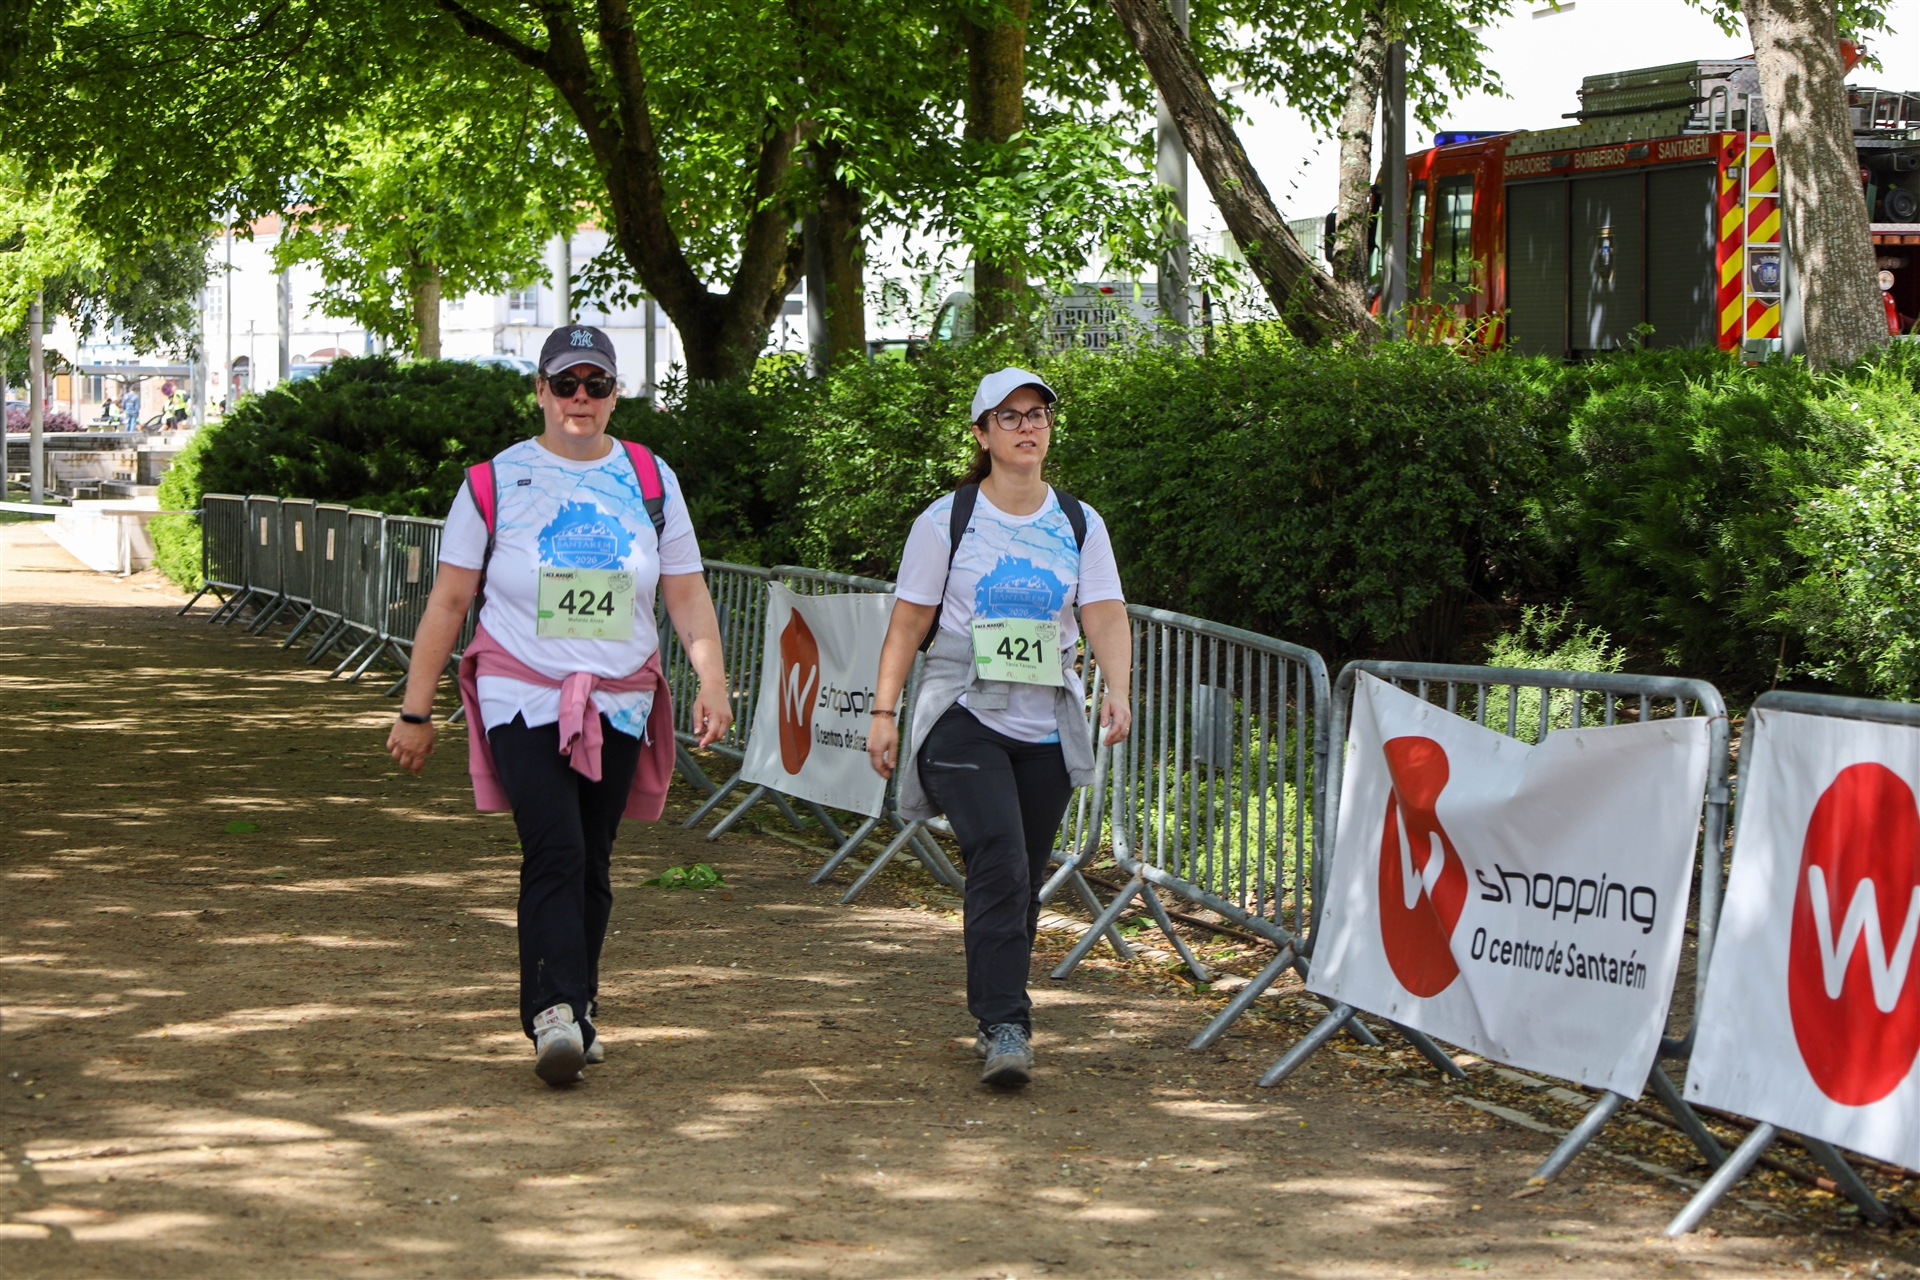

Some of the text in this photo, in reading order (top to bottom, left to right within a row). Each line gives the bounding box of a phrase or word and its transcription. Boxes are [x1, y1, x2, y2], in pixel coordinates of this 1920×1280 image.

[1504, 136, 1709, 176] SAPADORES BOMBEIROS SANTARÉM
[575, 555, 598, 565] 2026
[558, 589, 615, 616] 424
[1008, 607, 1029, 617] 2026
[996, 636, 1043, 663] 421
[818, 682, 876, 719] shoppin
[820, 729, 844, 749] centro
[1475, 863, 1657, 934] shopping
[1470, 927, 1647, 990] O centro de Santarém
